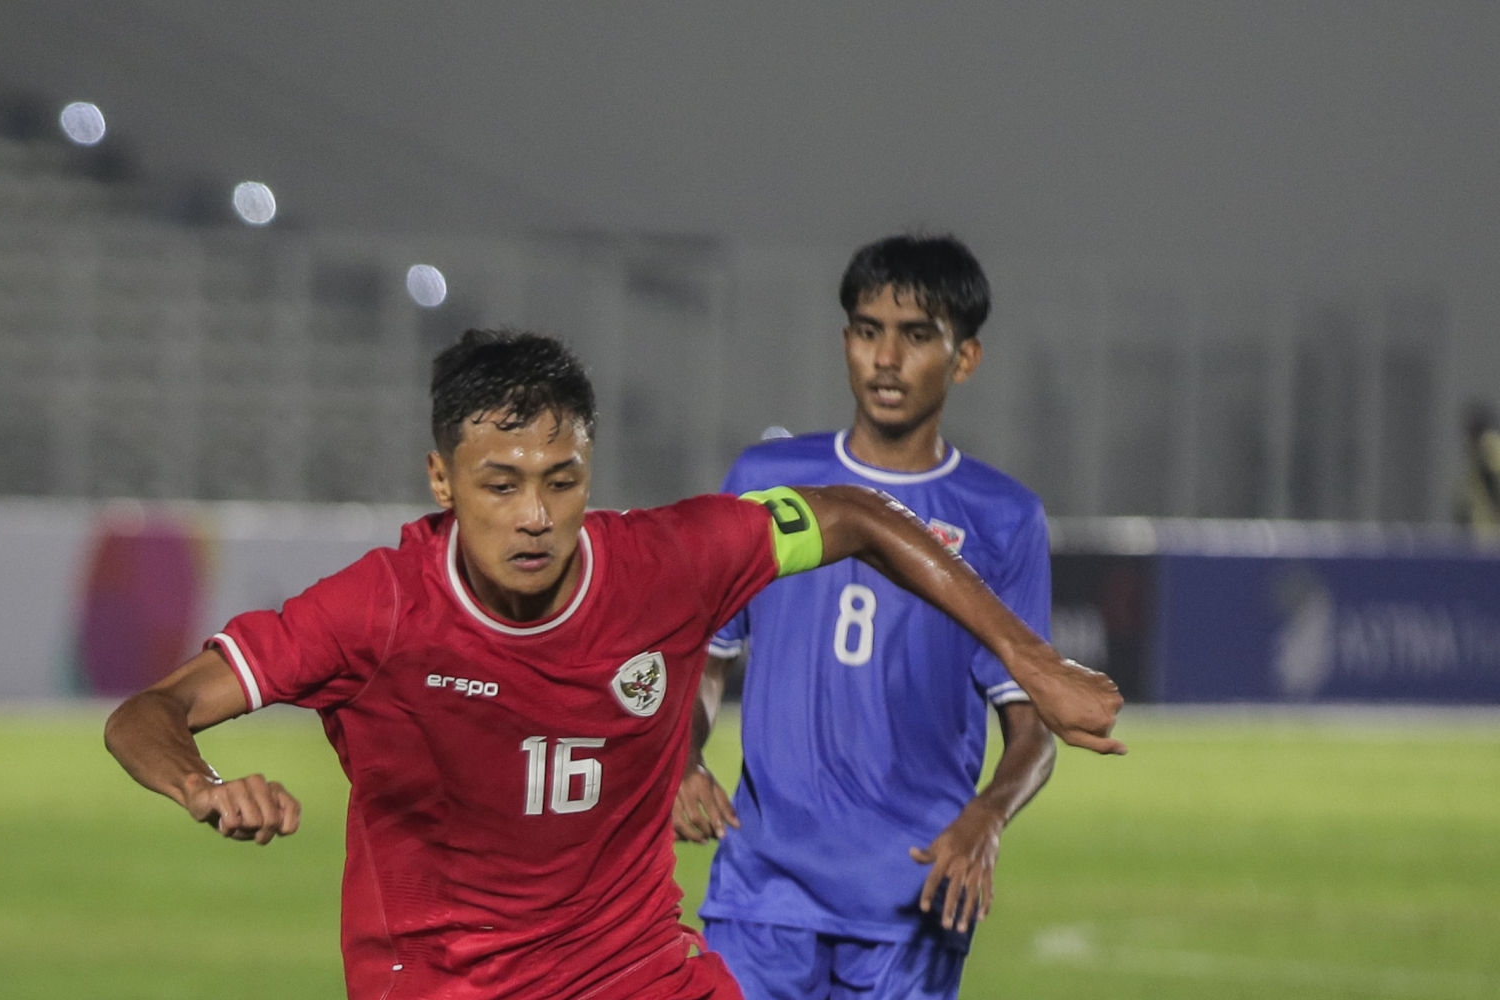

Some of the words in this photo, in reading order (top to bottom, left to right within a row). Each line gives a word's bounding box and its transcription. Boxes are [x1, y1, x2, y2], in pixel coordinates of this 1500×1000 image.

[834, 584, 876, 666] 8
[426, 673, 499, 697] erspo
[520, 735, 607, 815] 16
